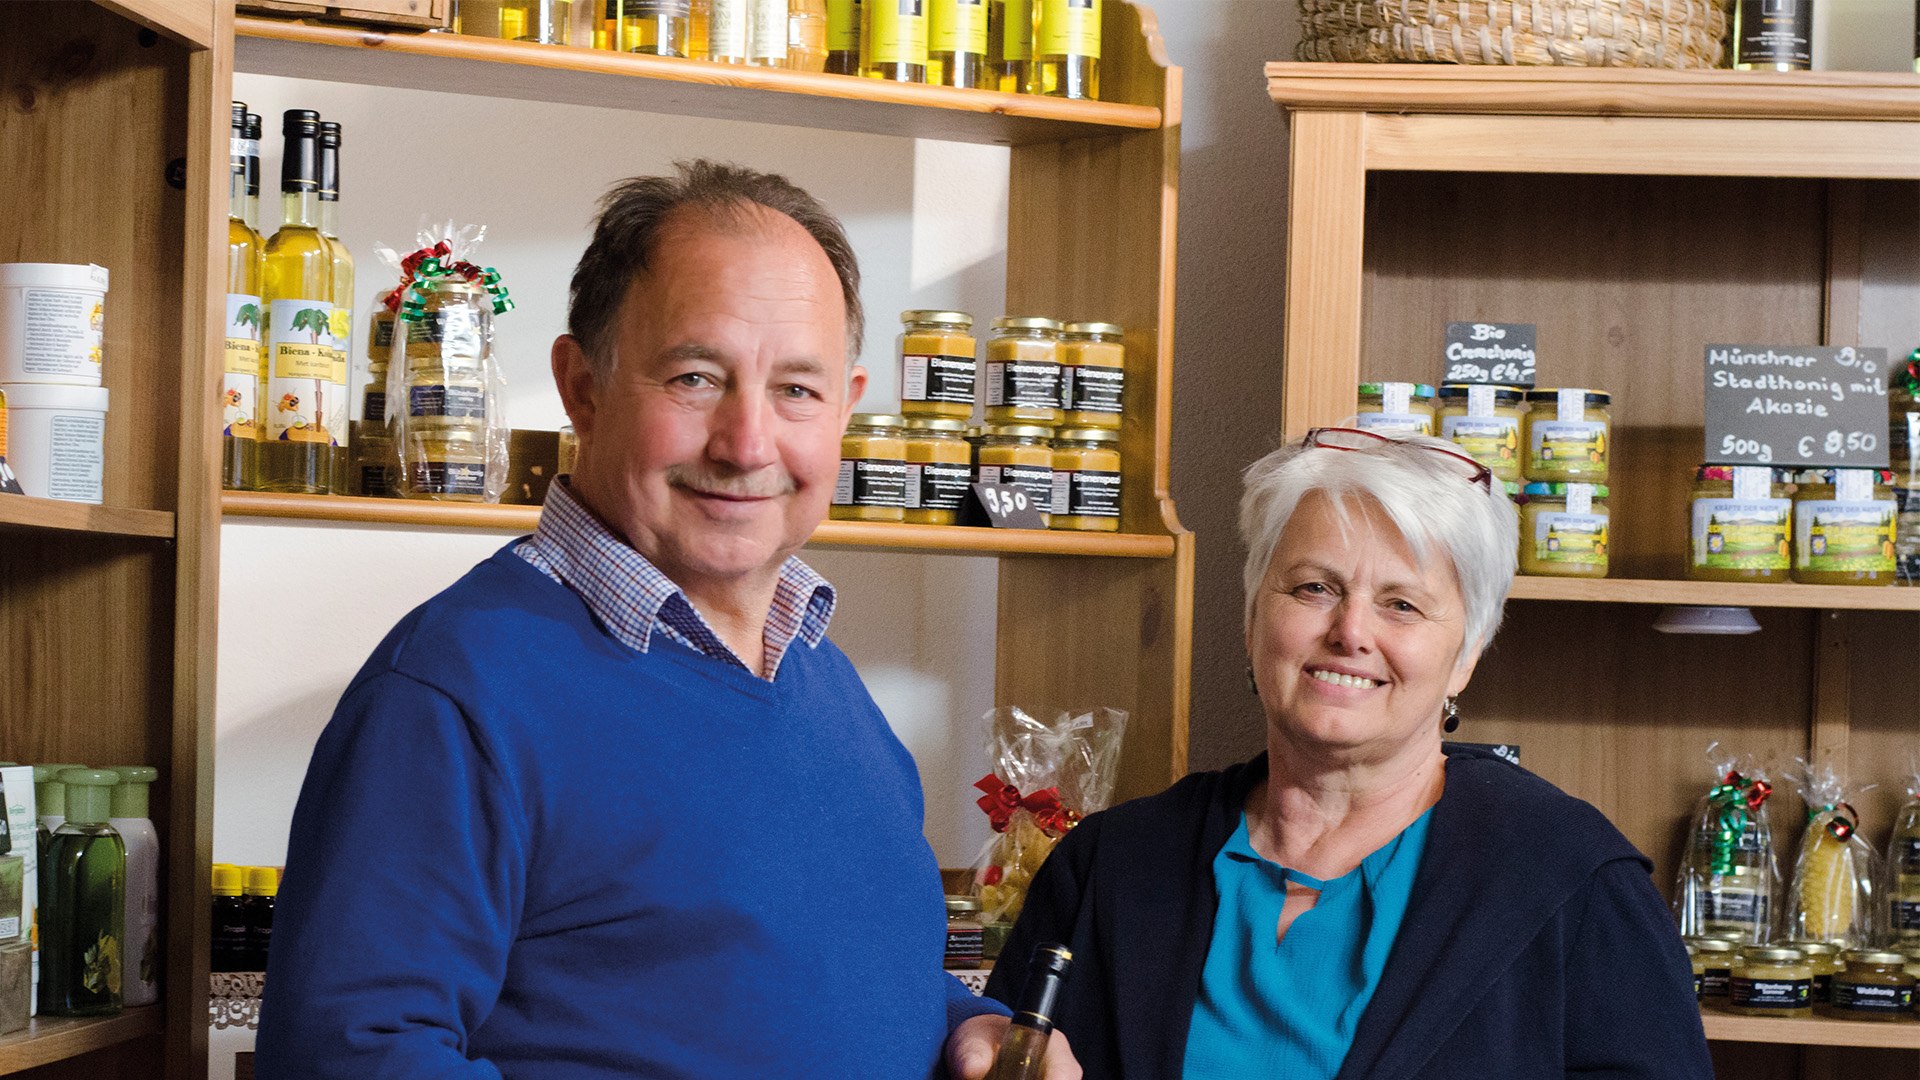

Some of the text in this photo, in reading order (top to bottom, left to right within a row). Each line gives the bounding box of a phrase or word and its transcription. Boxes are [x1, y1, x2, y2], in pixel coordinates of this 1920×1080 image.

[1470, 324, 1506, 340] Bio
[1710, 346, 1876, 374] Münchner Bio
[1713, 370, 1886, 401] Stadthonig mit
[1746, 397, 1828, 417] Akazie
[1720, 430, 1876, 462] 500g € 8,50
[984, 487, 1028, 518] 9,50
[1492, 744, 1520, 766] Bio
